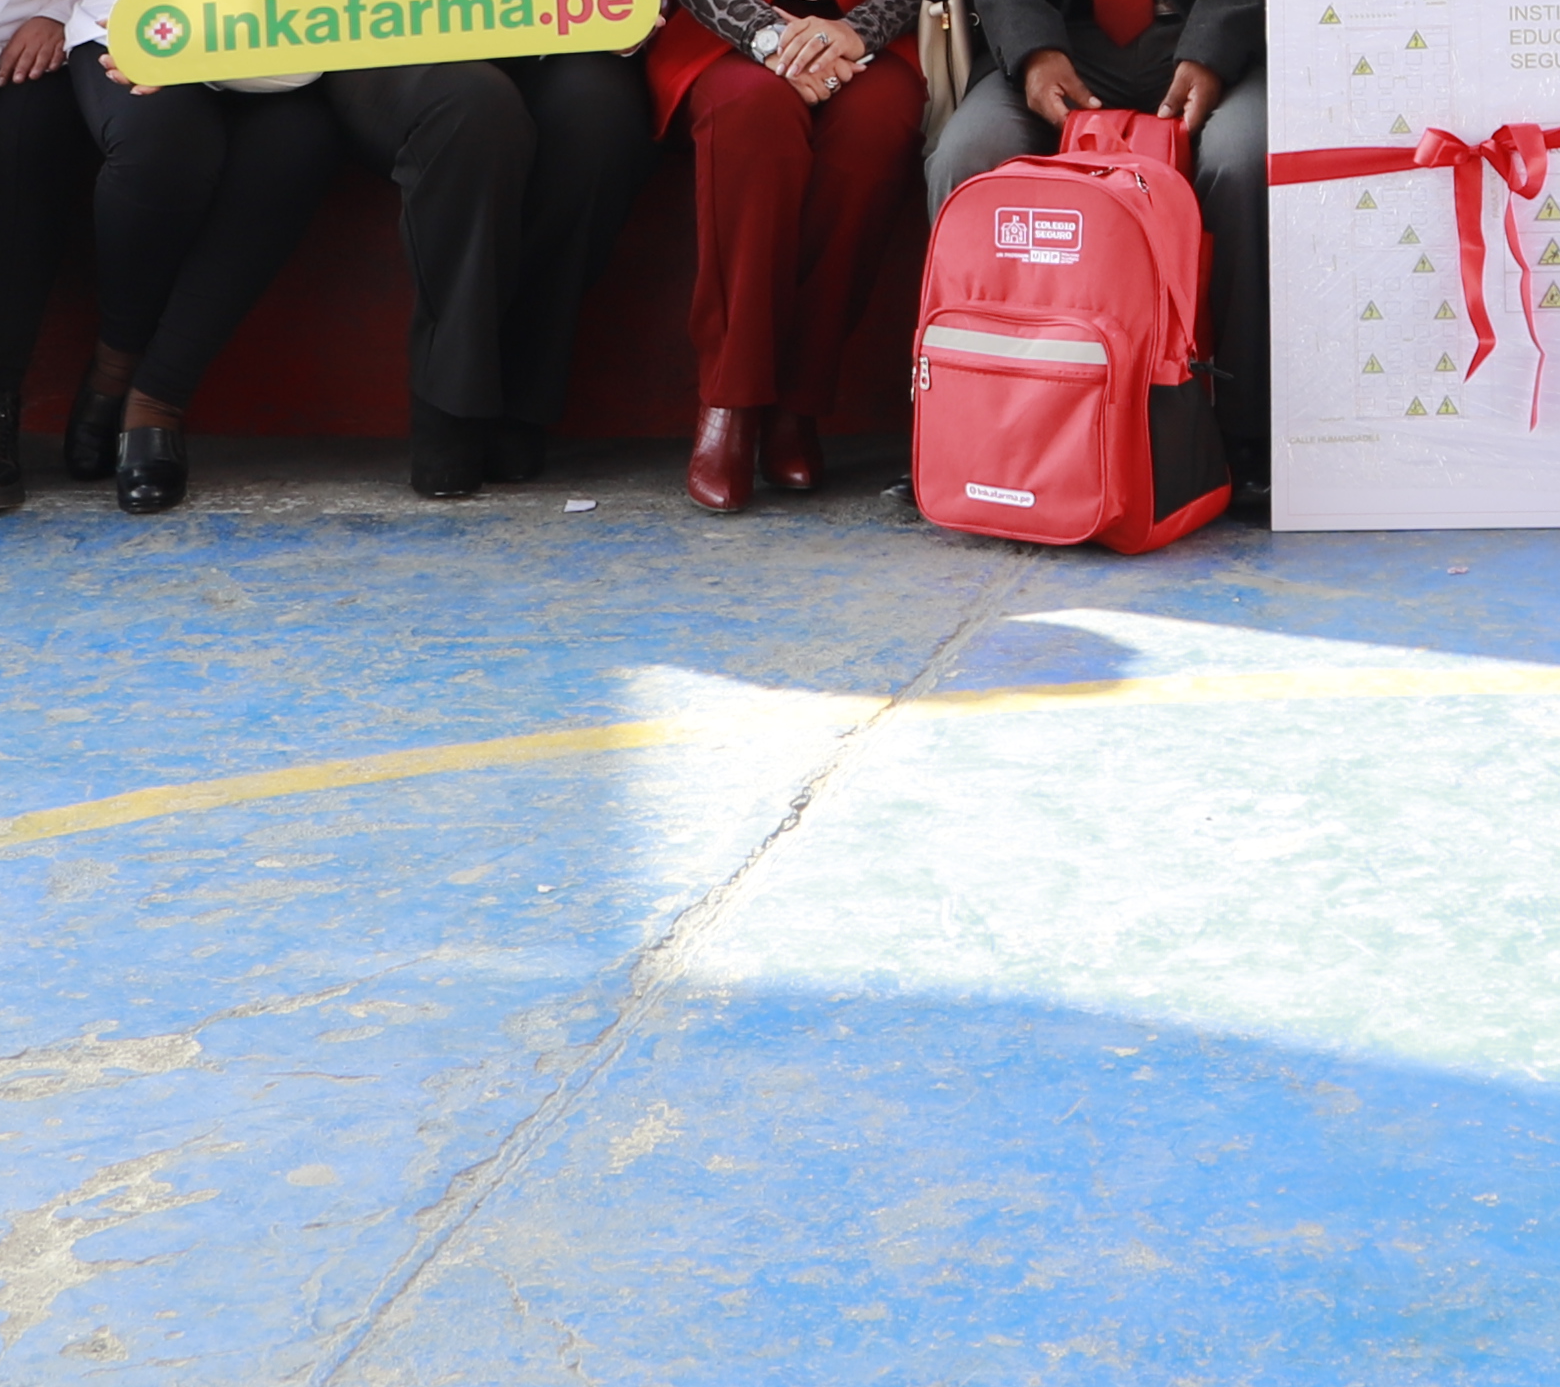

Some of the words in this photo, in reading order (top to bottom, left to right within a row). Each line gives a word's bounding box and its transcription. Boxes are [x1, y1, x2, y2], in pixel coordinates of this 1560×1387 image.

[1034, 220, 1076, 231] COLEGIO
[1035, 230, 1073, 240] SEGURO
[1288, 436, 1317, 445] CALLE
